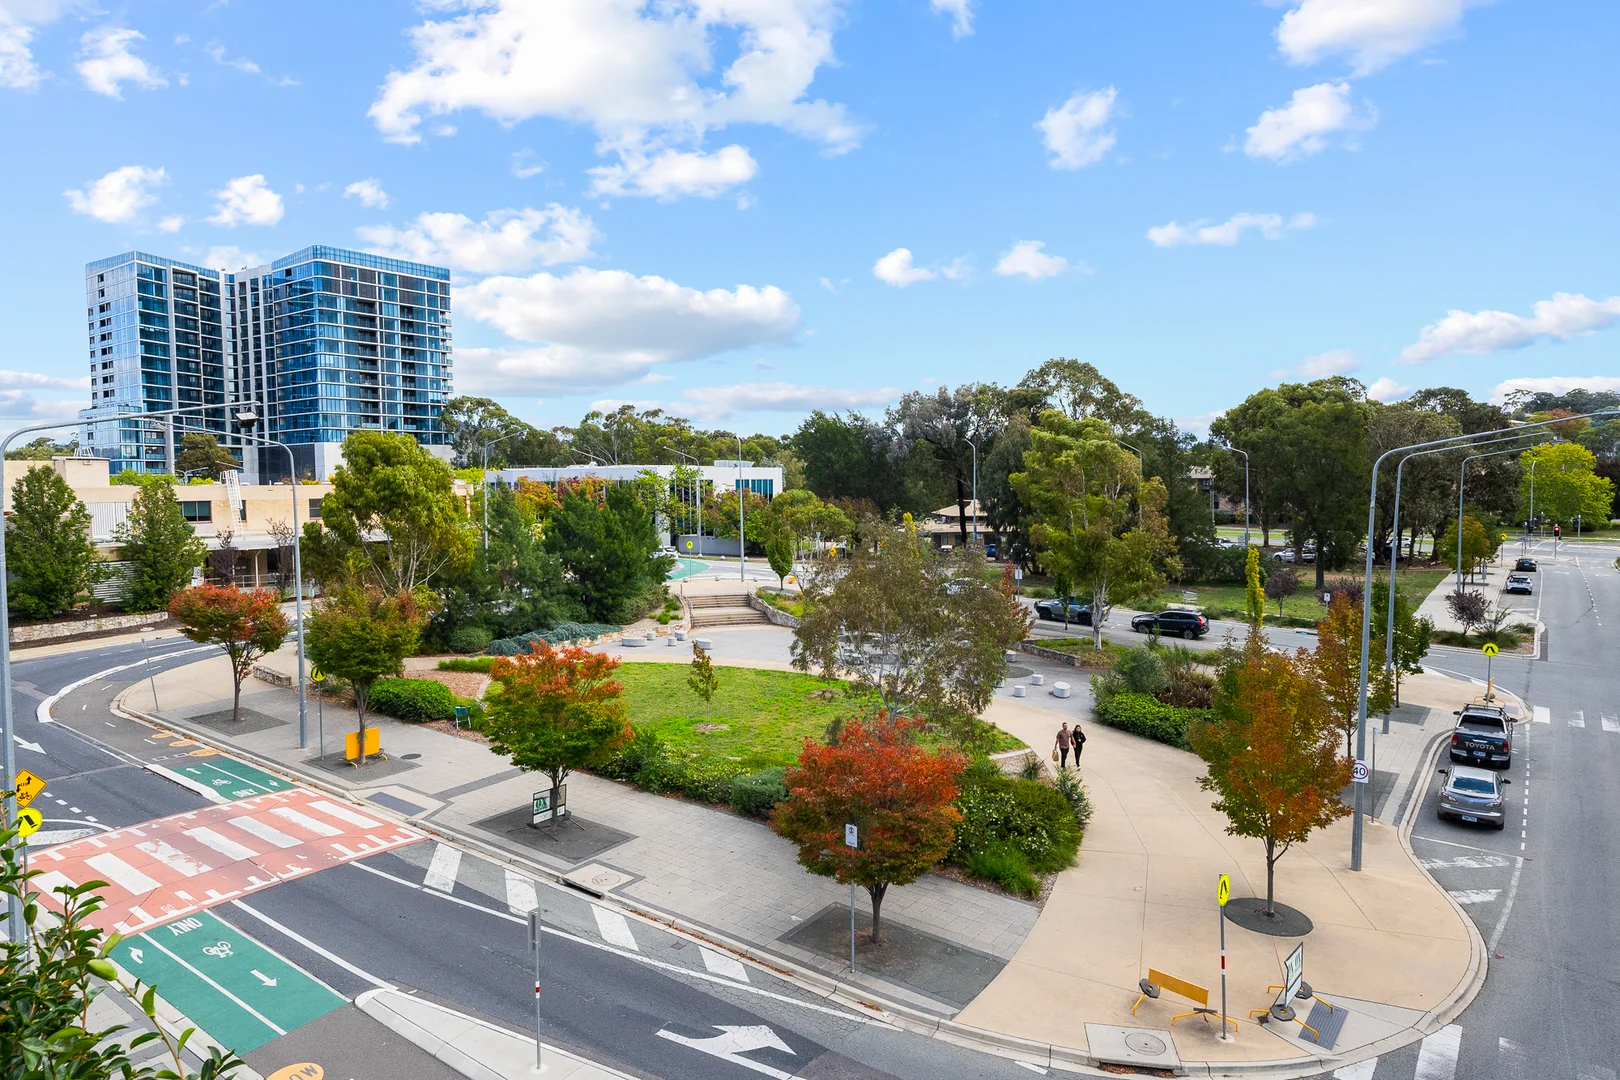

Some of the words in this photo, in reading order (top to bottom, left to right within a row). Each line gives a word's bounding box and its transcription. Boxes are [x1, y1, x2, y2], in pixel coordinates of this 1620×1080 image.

[1464, 741, 1495, 751] TOYOTA
[1353, 766, 1366, 776] 40
[166, 917, 204, 937] ONLY
